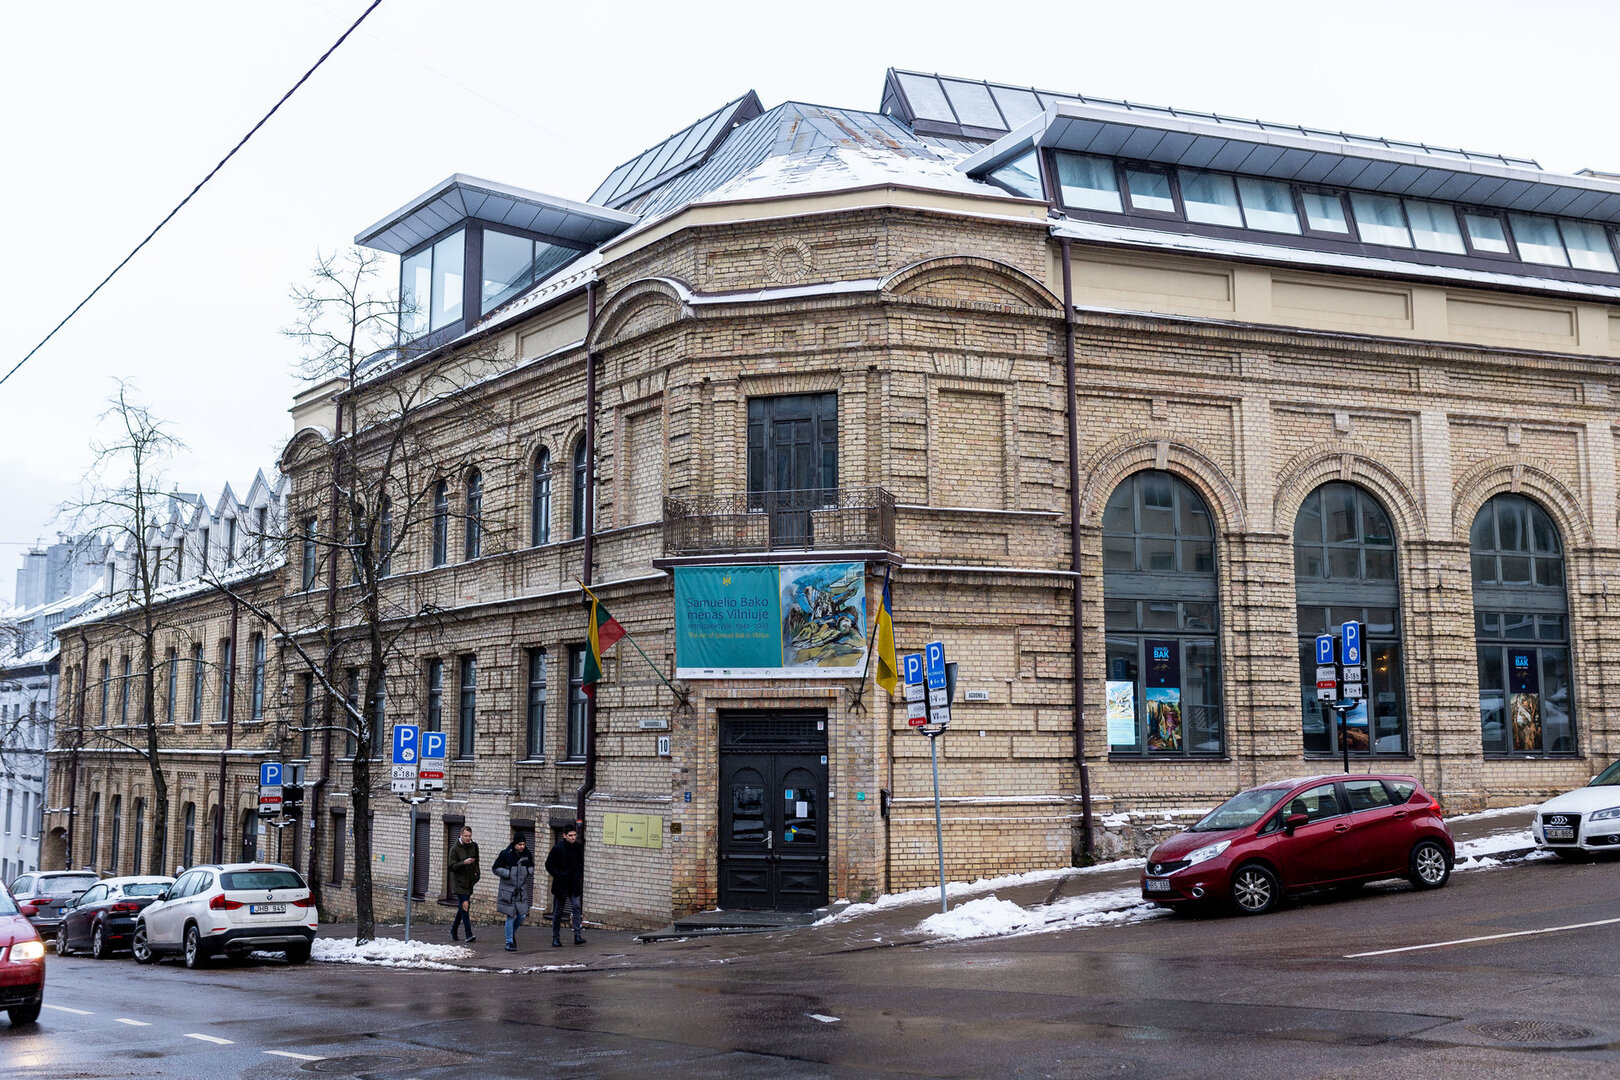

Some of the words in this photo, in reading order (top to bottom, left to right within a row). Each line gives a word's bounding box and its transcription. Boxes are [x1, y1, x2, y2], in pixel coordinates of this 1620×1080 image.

[687, 597, 737, 608] Samuelio
[741, 596, 769, 607] Bako
[687, 611, 724, 620] menas
[727, 609, 769, 621] Vilniuje
[1347, 626, 1356, 647] P
[930, 646, 940, 669] P
[1320, 639, 1330, 661] P
[908, 657, 919, 681] P
[401, 728, 414, 748] P
[428, 736, 442, 756] P
[660, 739, 668, 752] 10
[266, 766, 279, 784] P
[255, 904, 269, 912] JHB
[273, 904, 285, 912] 945
